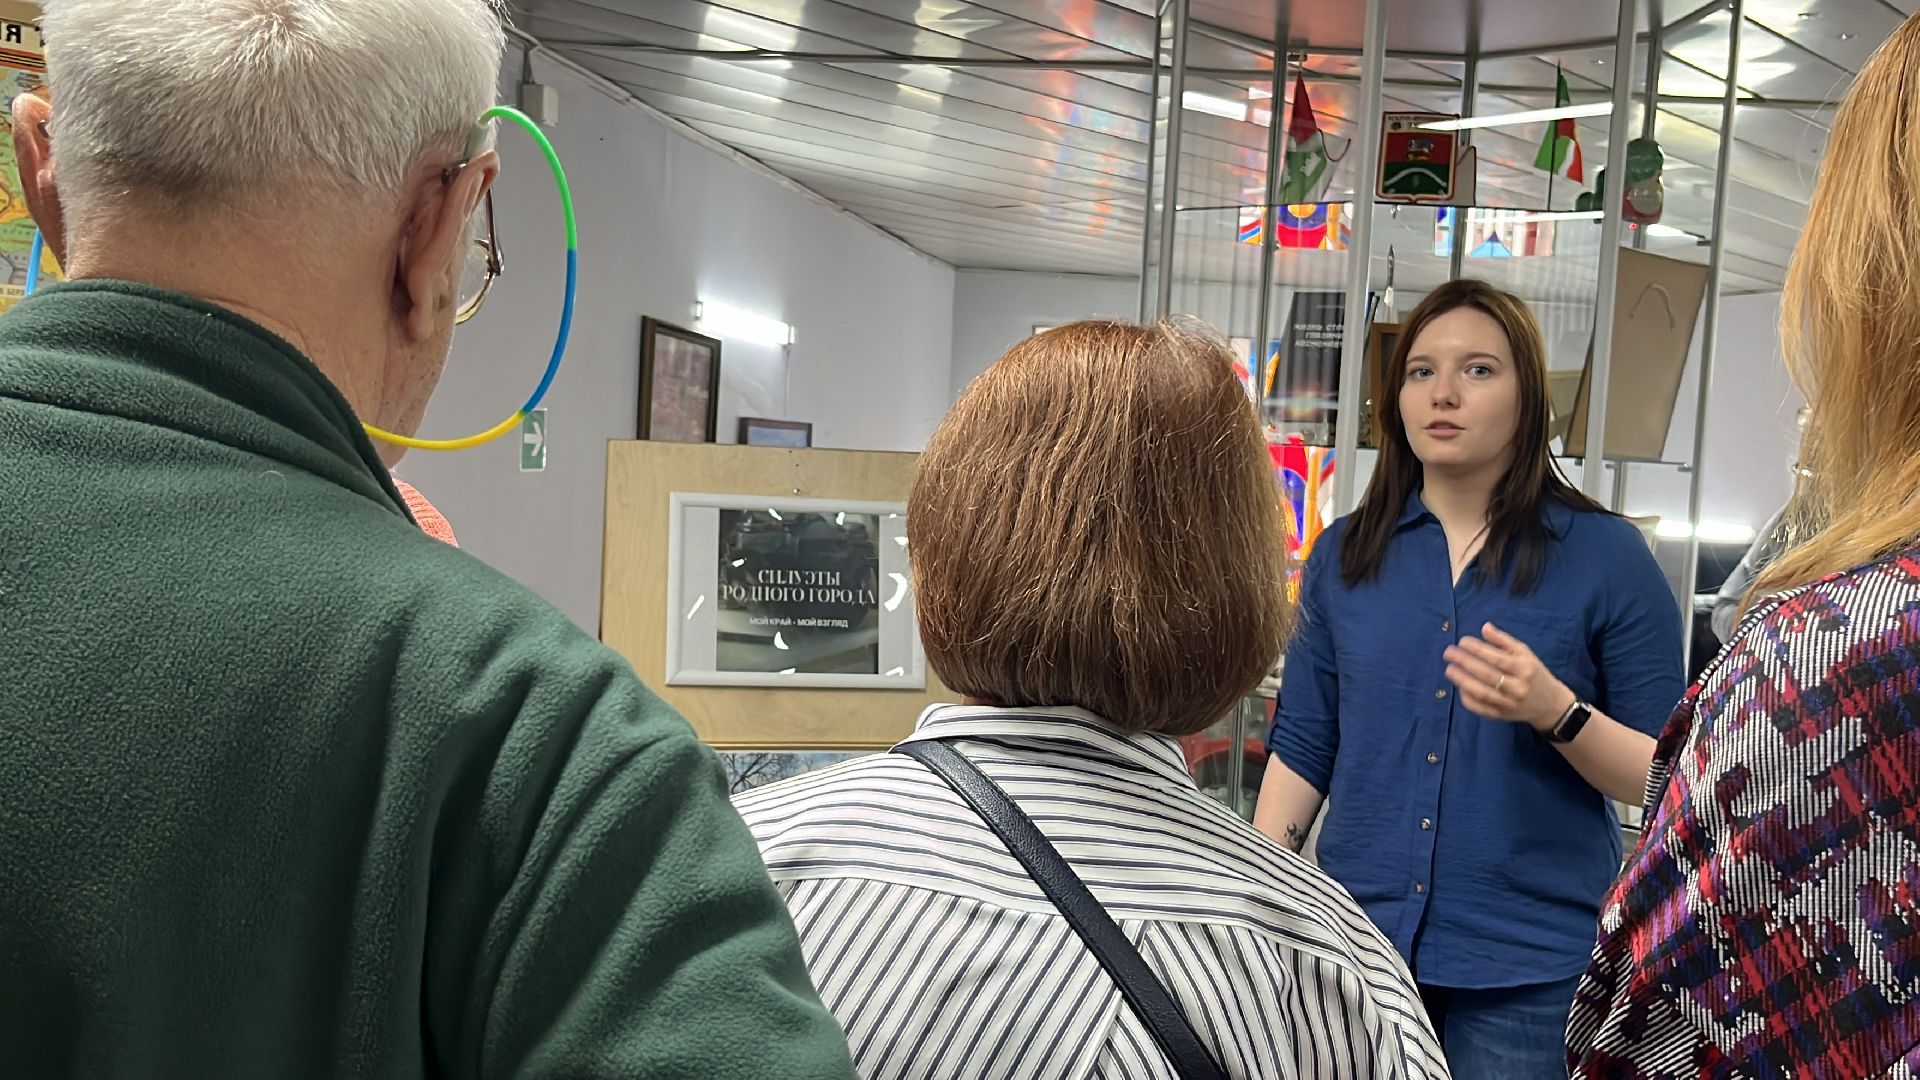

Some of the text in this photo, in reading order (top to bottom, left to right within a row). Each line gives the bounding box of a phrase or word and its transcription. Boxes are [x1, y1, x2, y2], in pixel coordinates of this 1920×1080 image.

[758, 569, 841, 586] СИЛУЭТЫ
[722, 584, 876, 606] РОДНОГО ГОРОДА
[749, 615, 769, 626] МОЙ
[769, 616, 792, 627] КРАЙ
[797, 616, 816, 627] МОЙ
[817, 618, 849, 629] ВЗГЛЯД
